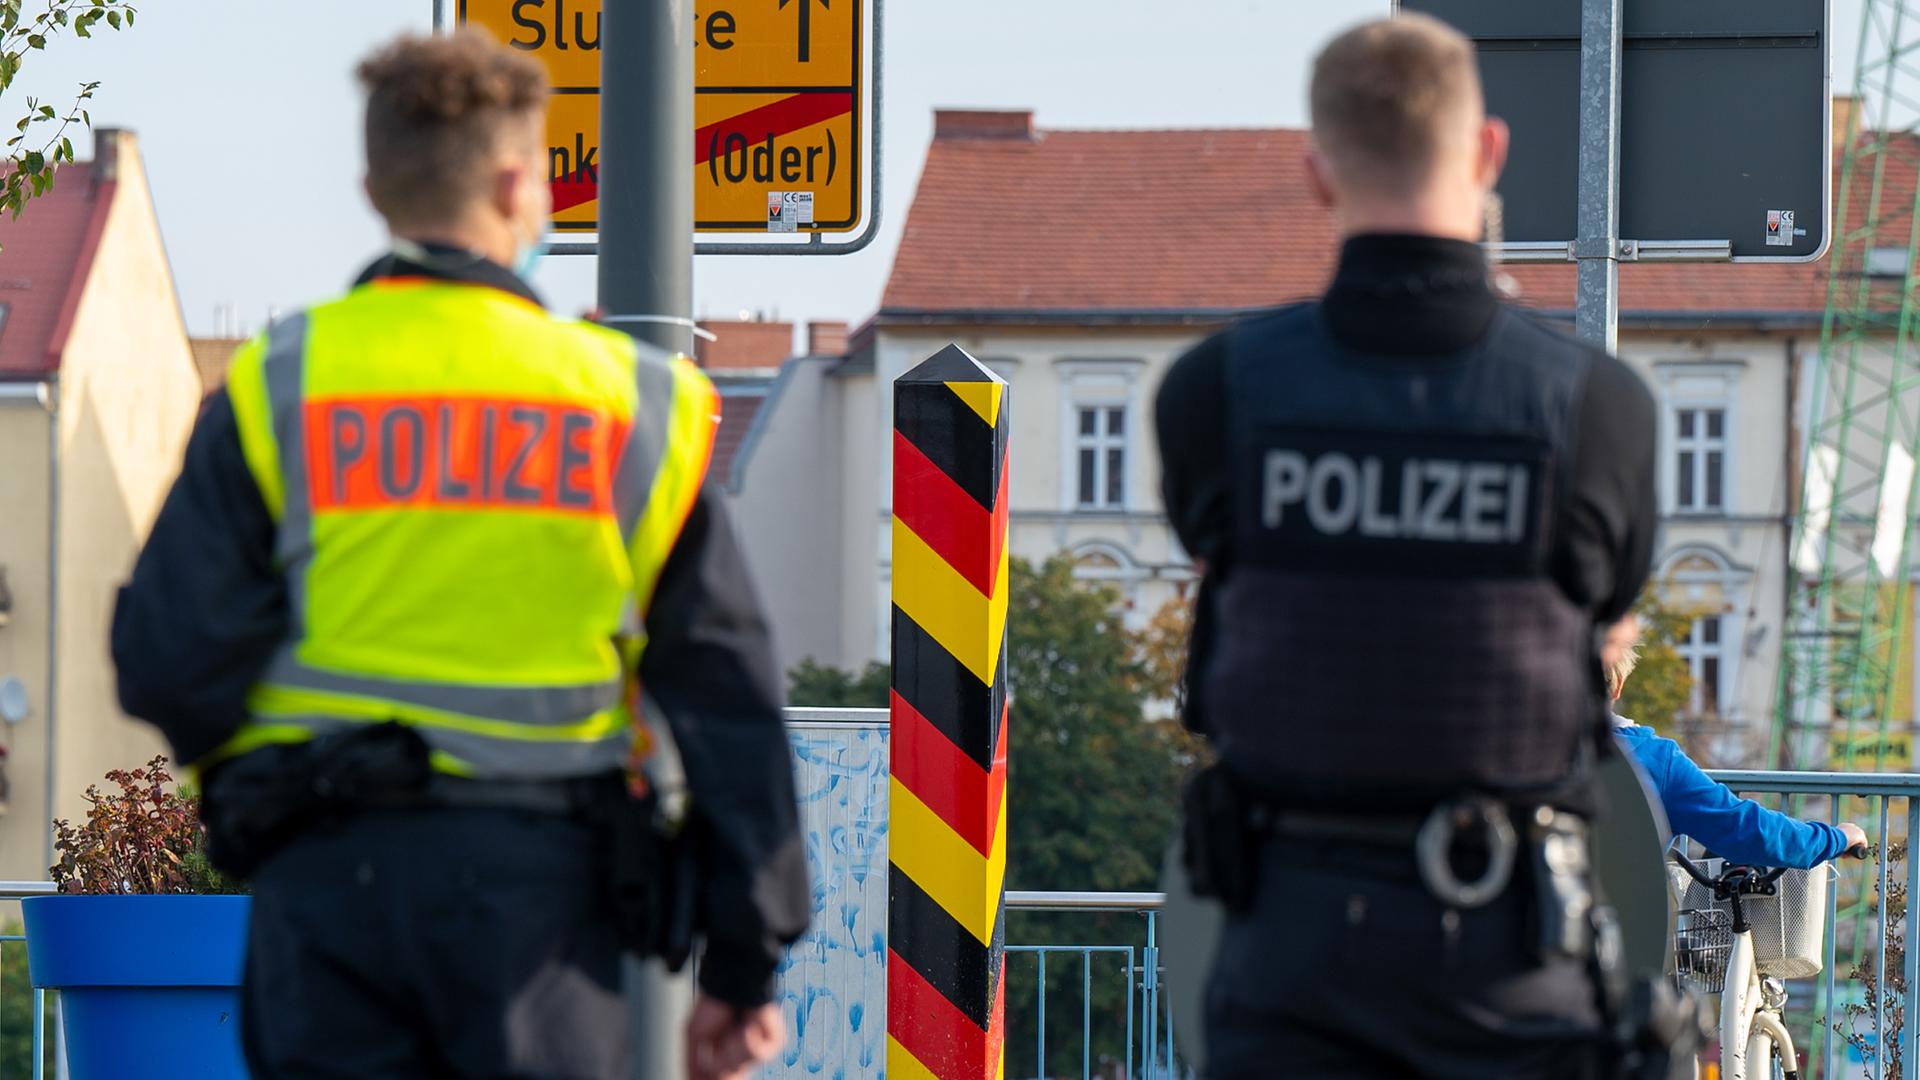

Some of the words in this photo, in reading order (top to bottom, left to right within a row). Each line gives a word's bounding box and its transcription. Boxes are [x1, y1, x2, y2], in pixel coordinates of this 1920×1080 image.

[510, 0, 736, 50] Slue
[709, 128, 836, 187] (Oder)
[1261, 450, 1529, 544] POLIZEI
